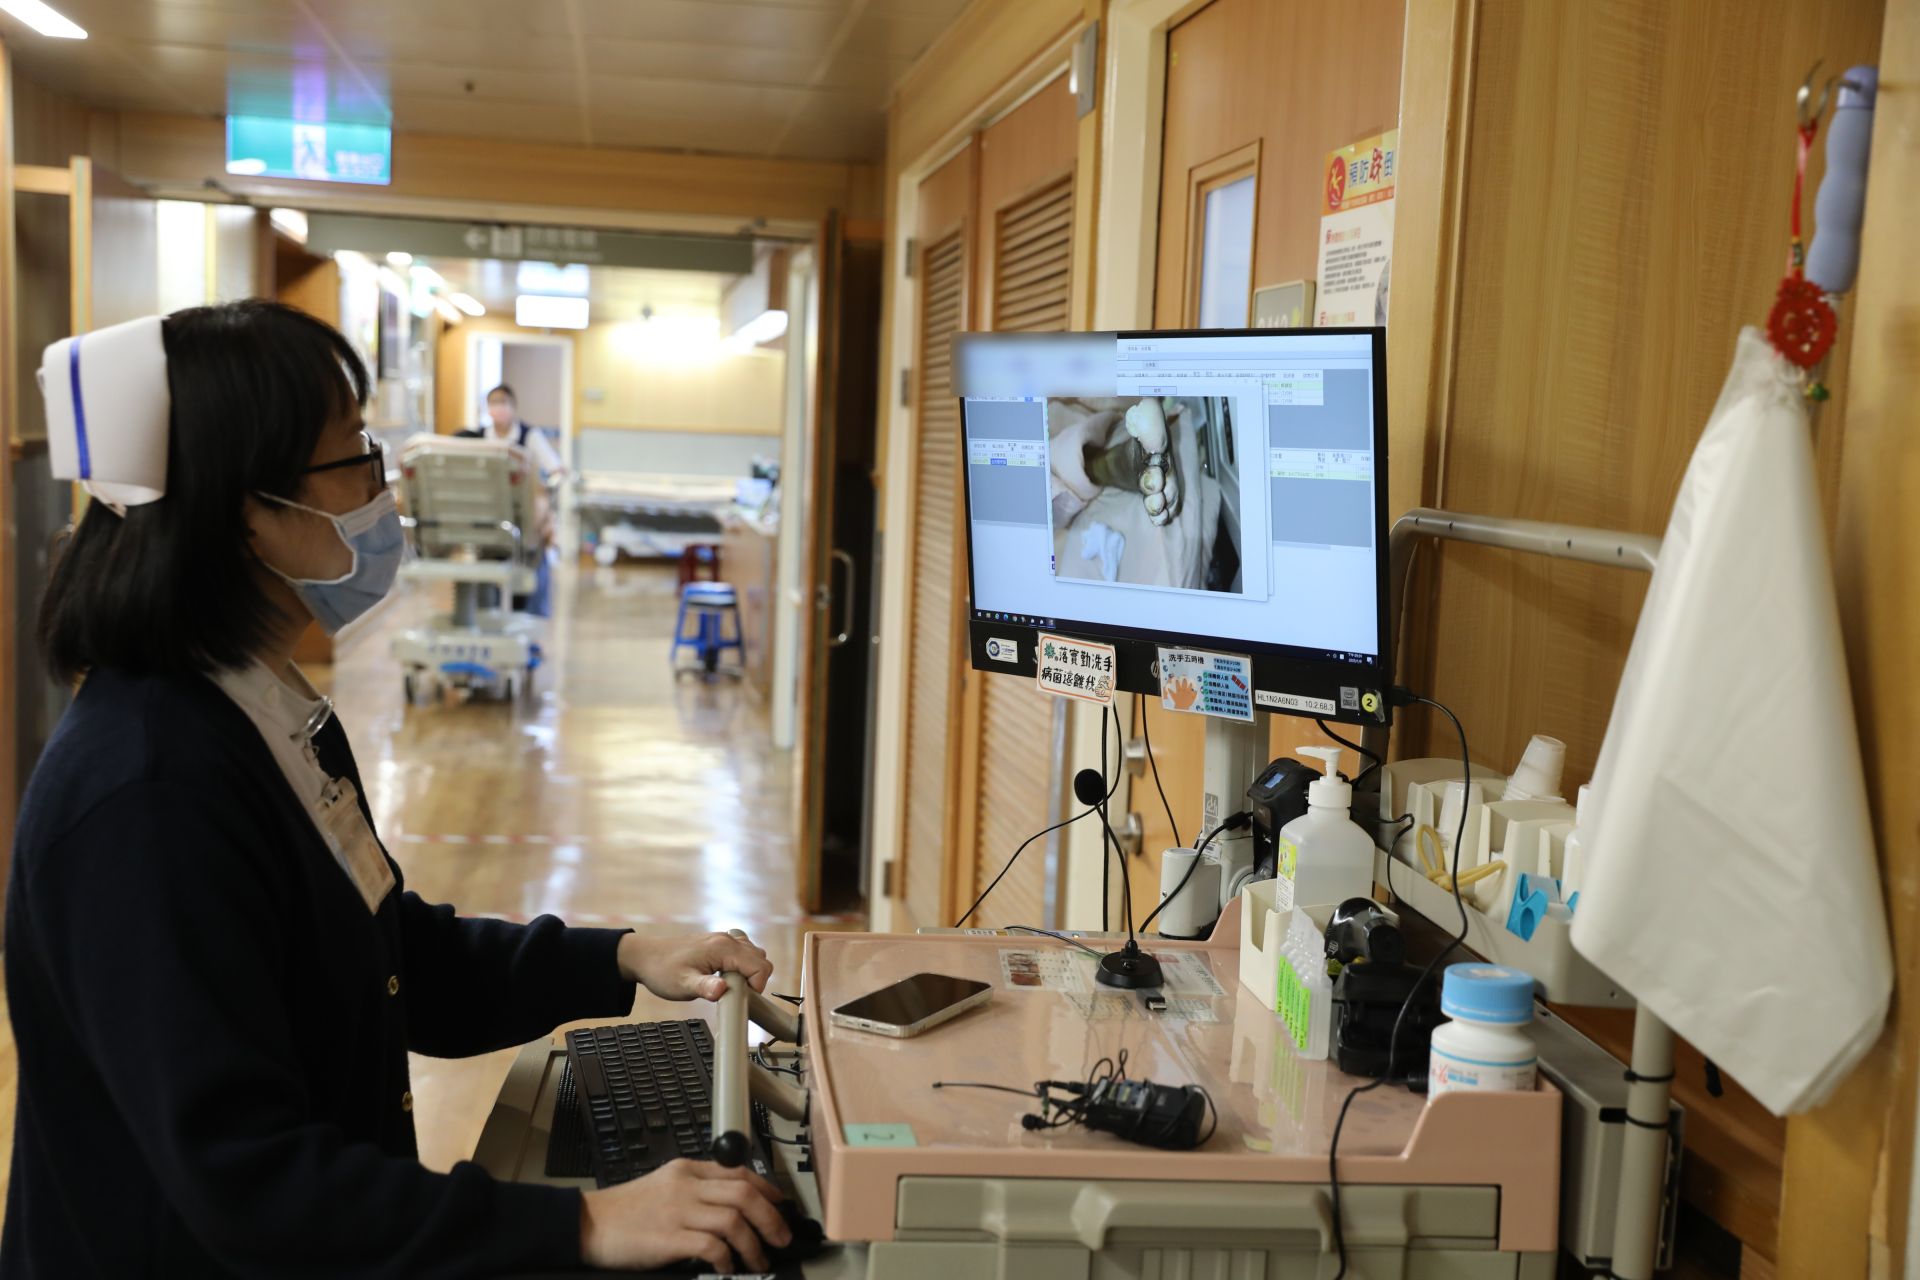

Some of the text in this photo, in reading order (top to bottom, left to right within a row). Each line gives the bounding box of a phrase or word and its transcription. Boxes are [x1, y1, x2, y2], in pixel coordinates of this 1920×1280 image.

[1059, 646, 1113, 673] 落實勤洗手
[1168, 653, 1205, 665] 洗手五時機
[1041, 666, 1096, 693] 病菌遠離我
[1366, 698, 1372, 707] 2
